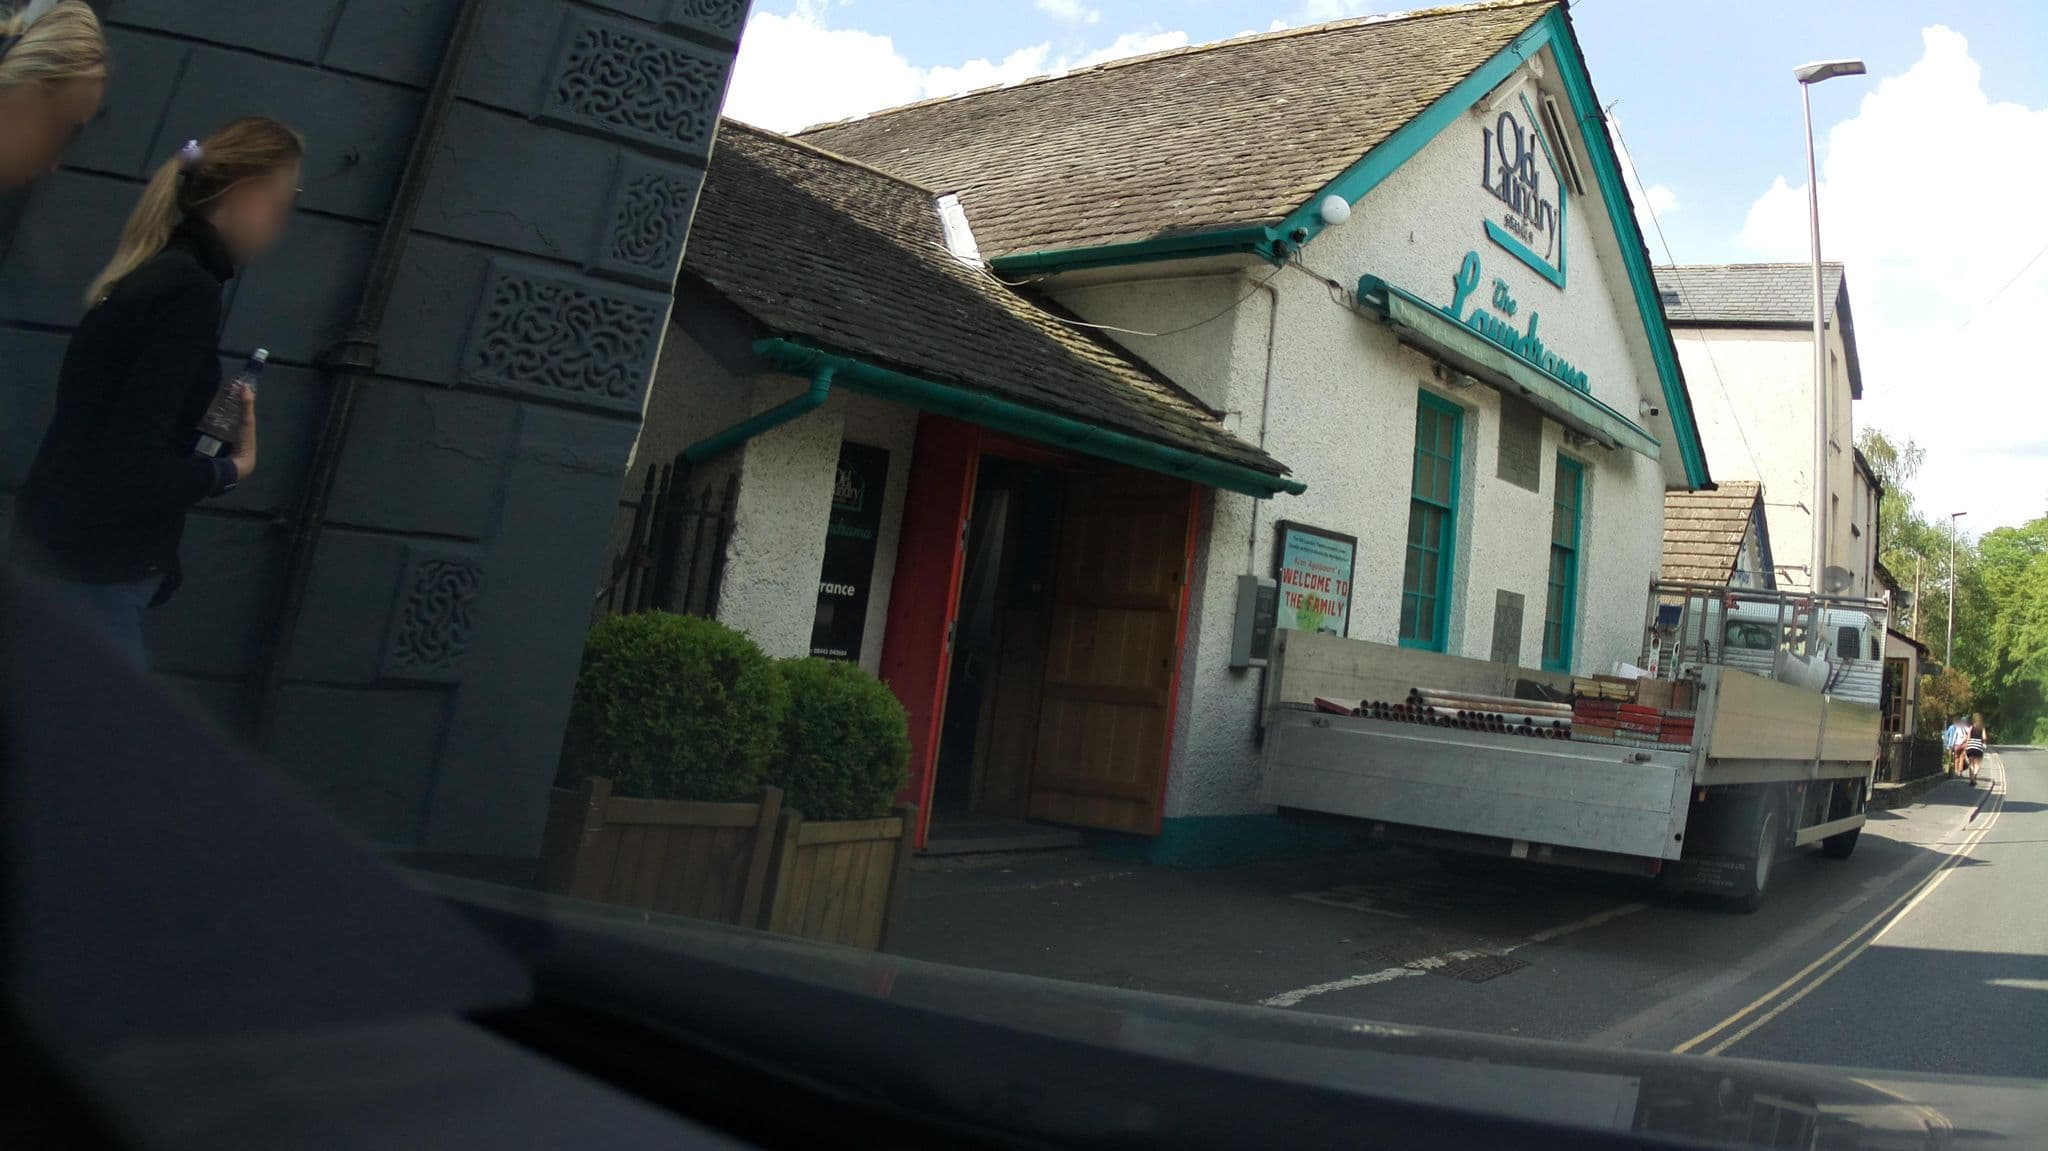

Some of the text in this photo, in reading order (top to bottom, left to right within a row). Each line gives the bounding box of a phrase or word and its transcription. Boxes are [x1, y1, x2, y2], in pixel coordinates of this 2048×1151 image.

[1497, 111, 1536, 187] Old
[1483, 127, 1557, 260] Laundry
[1492, 277, 1518, 316] The
[820, 582, 855, 596] rance
[1283, 567, 1348, 597] WELCOME TO
[1285, 591, 1344, 617] THE FAMILY
